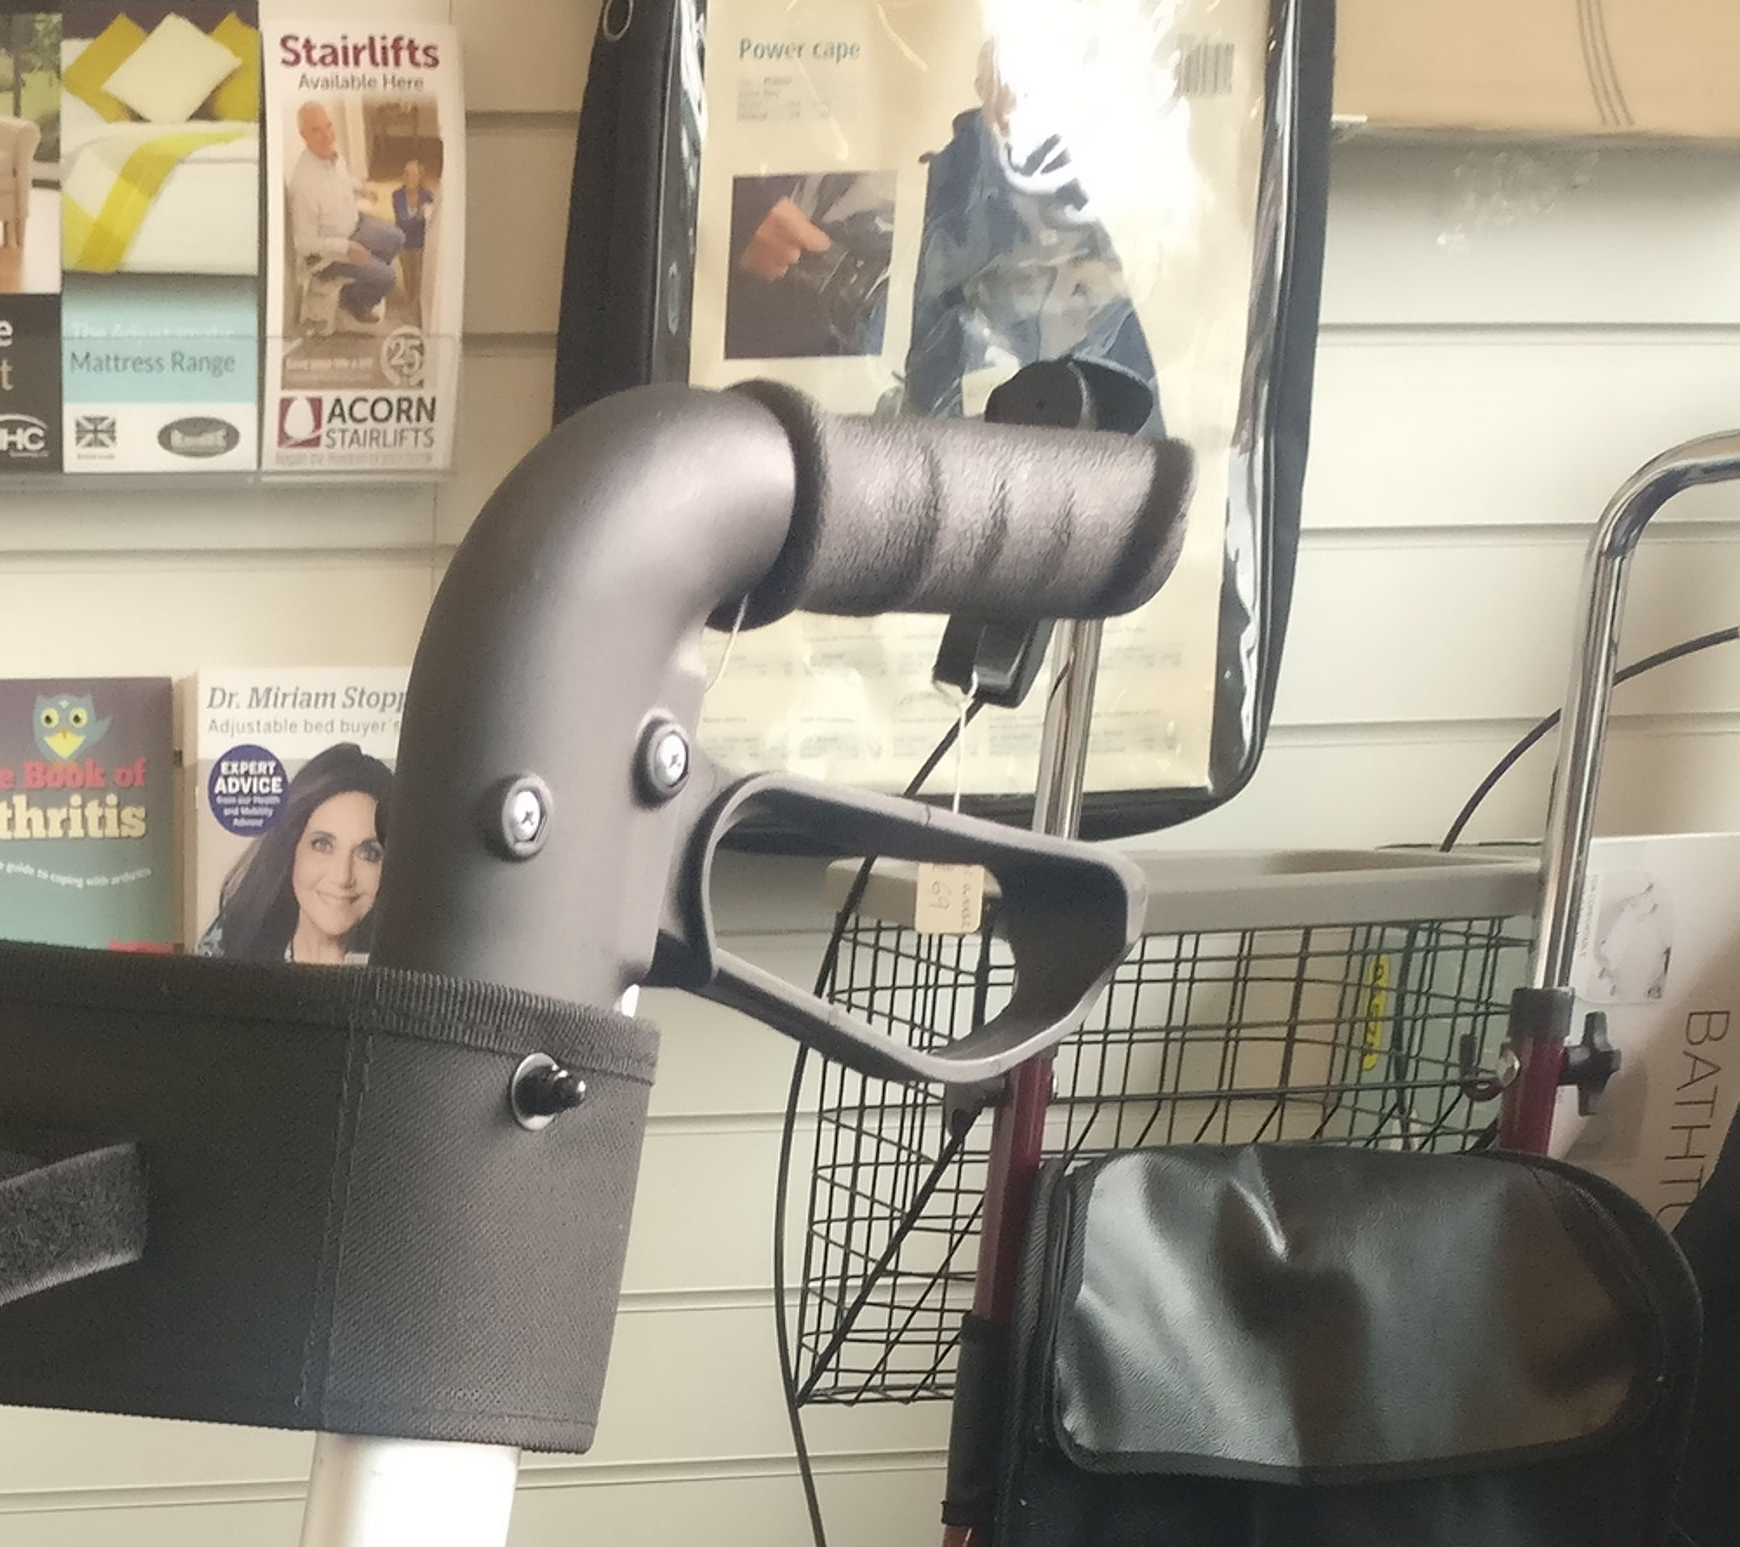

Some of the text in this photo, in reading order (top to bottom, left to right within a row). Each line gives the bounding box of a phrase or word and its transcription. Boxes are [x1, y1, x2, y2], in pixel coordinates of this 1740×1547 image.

[280, 34, 440, 68] Stairlifts
[739, 37, 860, 64] Power cape
[298, 75, 424, 90] Available Here
[70, 350, 236, 377] Mattress Range
[327, 396, 436, 424] ACORN
[325, 427, 435, 449] STAIRLIFTS
[207, 687, 240, 710] Dr.
[247, 686, 336, 710] Miriam
[208, 718, 298, 739] Adjustable
[304, 718, 334, 734] bed
[23, 757, 105, 790] Book
[114, 757, 147, 789] of
[220, 761, 276, 776] EXPERT
[214, 777, 284, 795] ADVICE
